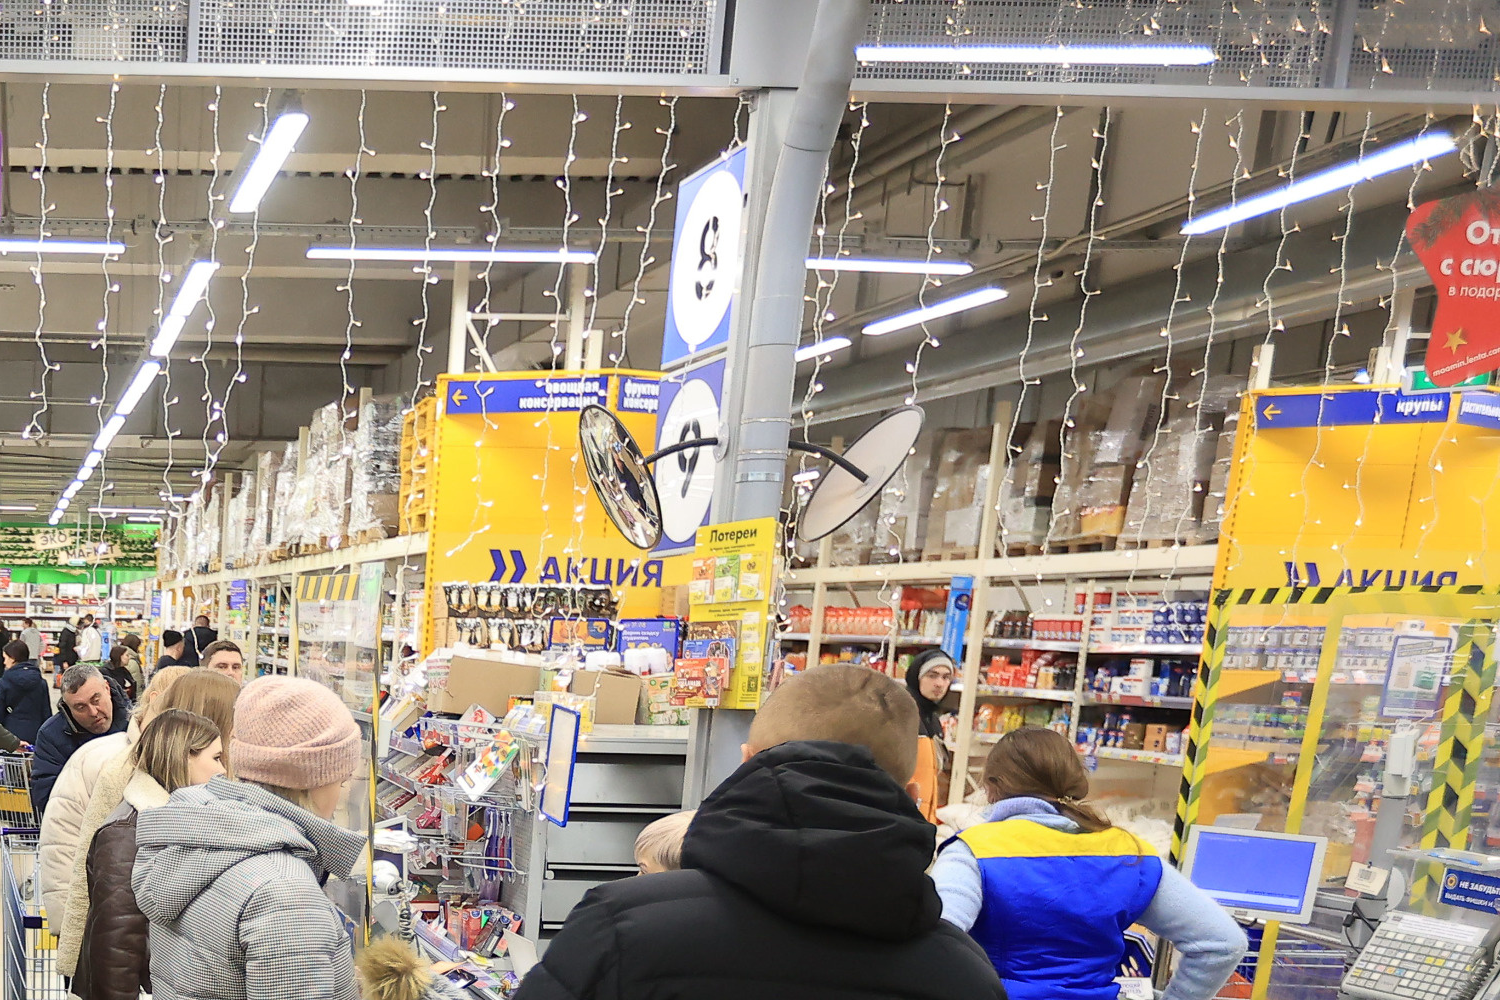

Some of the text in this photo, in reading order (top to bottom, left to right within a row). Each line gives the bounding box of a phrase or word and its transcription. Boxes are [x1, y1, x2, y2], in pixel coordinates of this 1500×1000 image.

[694, 215, 720, 300] 8
[1439, 258, 1454, 275] с
[1448, 286, 1456, 296] в
[545, 380, 600, 394] овощная
[519, 395, 599, 411] консервация
[1396, 399, 1443, 416] крупы
[677, 417, 701, 499] 9
[40, 533, 67, 546] ЭКО
[709, 527, 757, 545] Лотереи
[540, 556, 664, 587] АКЦИЯ
[1459, 880, 1468, 889] НЕ
